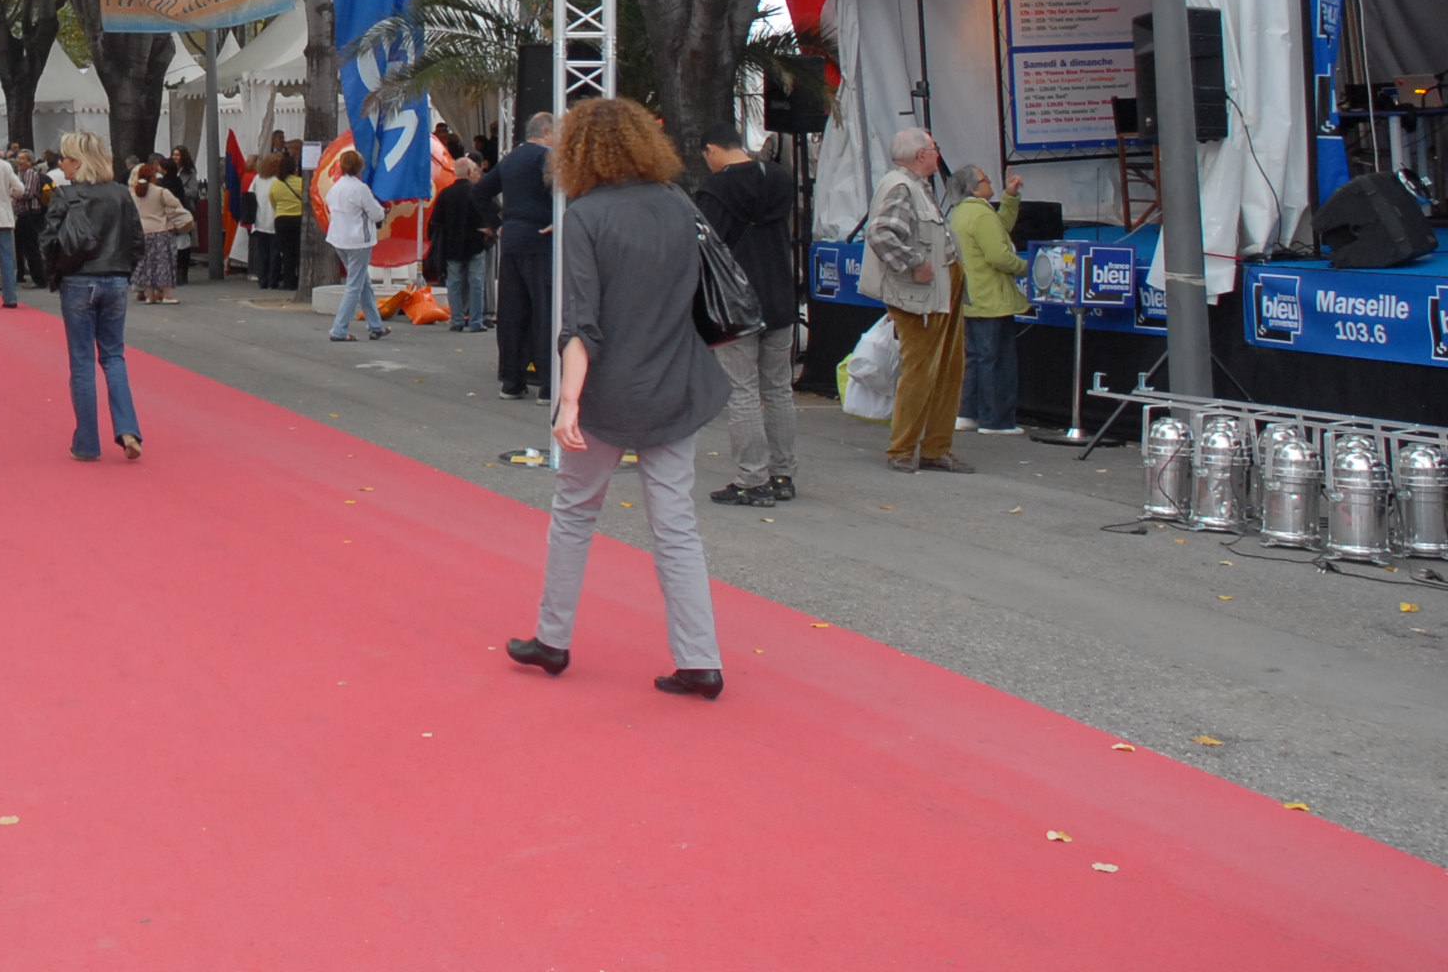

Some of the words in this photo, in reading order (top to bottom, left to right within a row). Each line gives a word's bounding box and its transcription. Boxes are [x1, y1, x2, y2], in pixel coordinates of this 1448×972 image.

[1023, 60, 1057, 69] Samedi
[1060, 59, 1067, 67] &
[1070, 58, 1113, 67] dimanche
[1108, 261, 1130, 270] france
[1092, 265, 1130, 284] bleu
[1099, 284, 1130, 292] provence
[1276, 292, 1296, 303] france
[1262, 295, 1298, 320] bleu
[1316, 290, 1410, 319] Marseille
[1268, 318, 1298, 328] provence
[1335, 320, 1388, 344] 103.6
